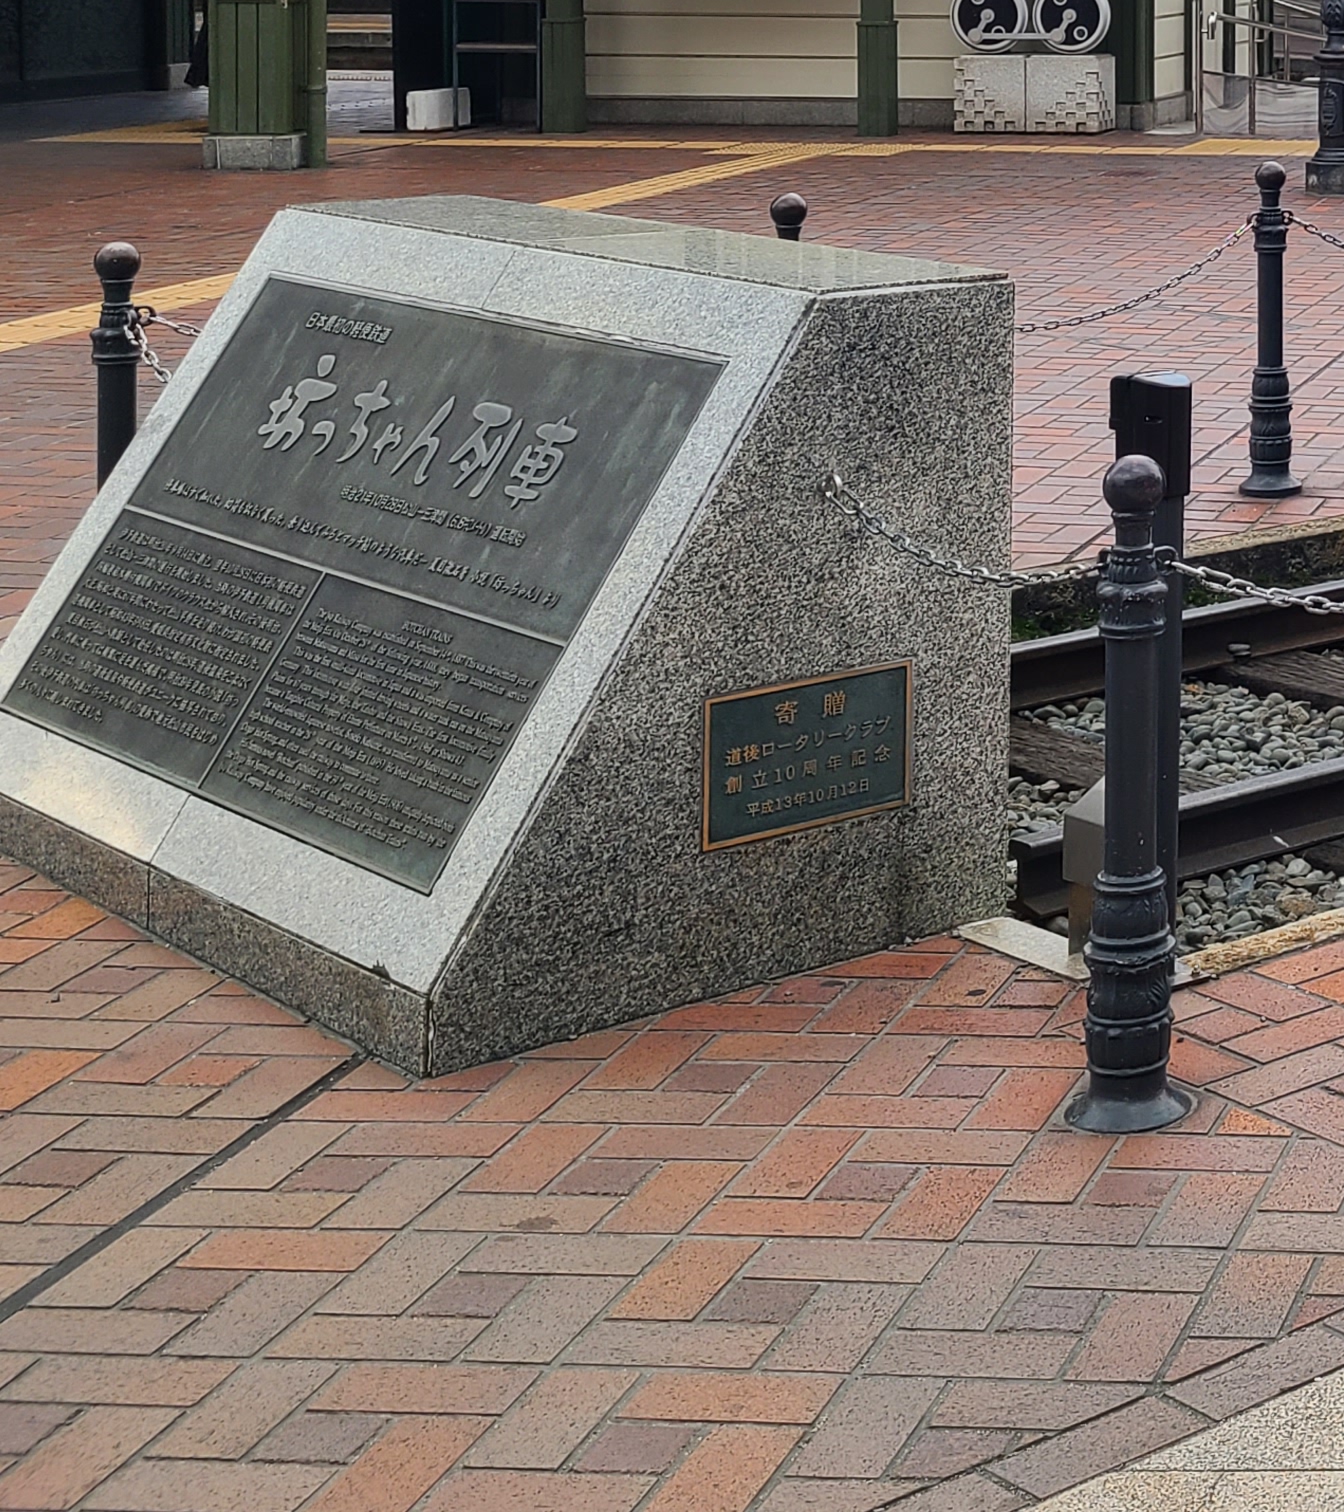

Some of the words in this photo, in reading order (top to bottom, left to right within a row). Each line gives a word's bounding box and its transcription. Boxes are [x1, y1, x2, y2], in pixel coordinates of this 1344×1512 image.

[305, 312, 393, 345] 日本最初の軽便鉄道
[257, 354, 578, 510] 坊っちゃん列車
[775, 690, 847, 725] 寄贈
[724, 715, 892, 767] 道後ロータリークラブ
[724, 743, 892, 795] 創立10周年記念
[746, 778, 870, 817] 平成13年10月12日
